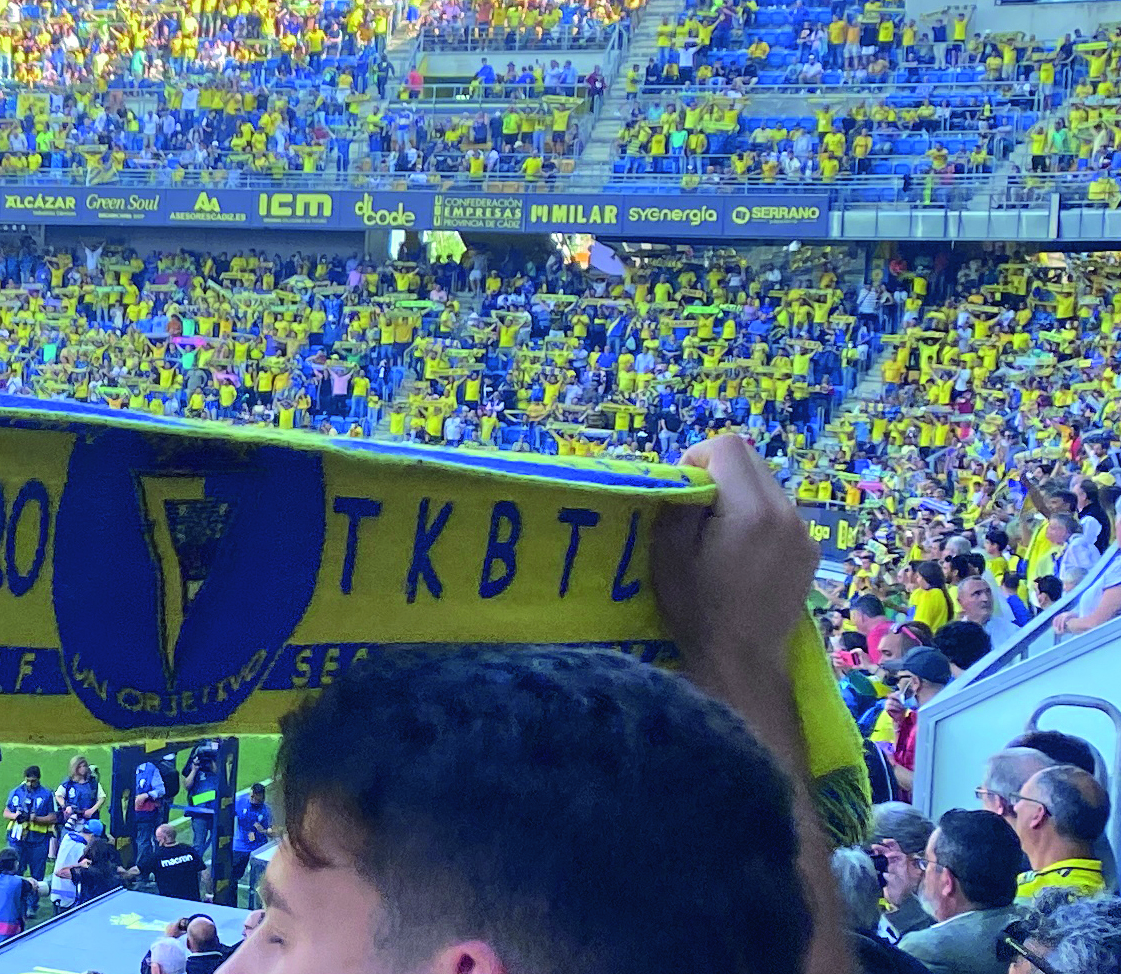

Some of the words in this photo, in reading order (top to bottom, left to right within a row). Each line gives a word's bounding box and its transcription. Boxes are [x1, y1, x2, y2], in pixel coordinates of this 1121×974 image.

[5, 193, 76, 209] ALCÁZAR
[86, 193, 125, 210] Green
[128, 195, 160, 211] Soul
[258, 193, 332, 217] ICM
[444, 197, 523, 208] CONFEDERACIÓN
[444, 207, 522, 218] EMPRESAS
[551, 204, 618, 224] MILAR
[751, 206, 820, 219] SERRANO
[443, 218, 484, 228] PROVINCIA
[485, 219, 495, 227] DE
[333, 495, 383, 596] T
[406, 496, 453, 604] K
[479, 500, 523, 600] B
[557, 506, 600, 599] T
[160, 854, 193, 868] macron
